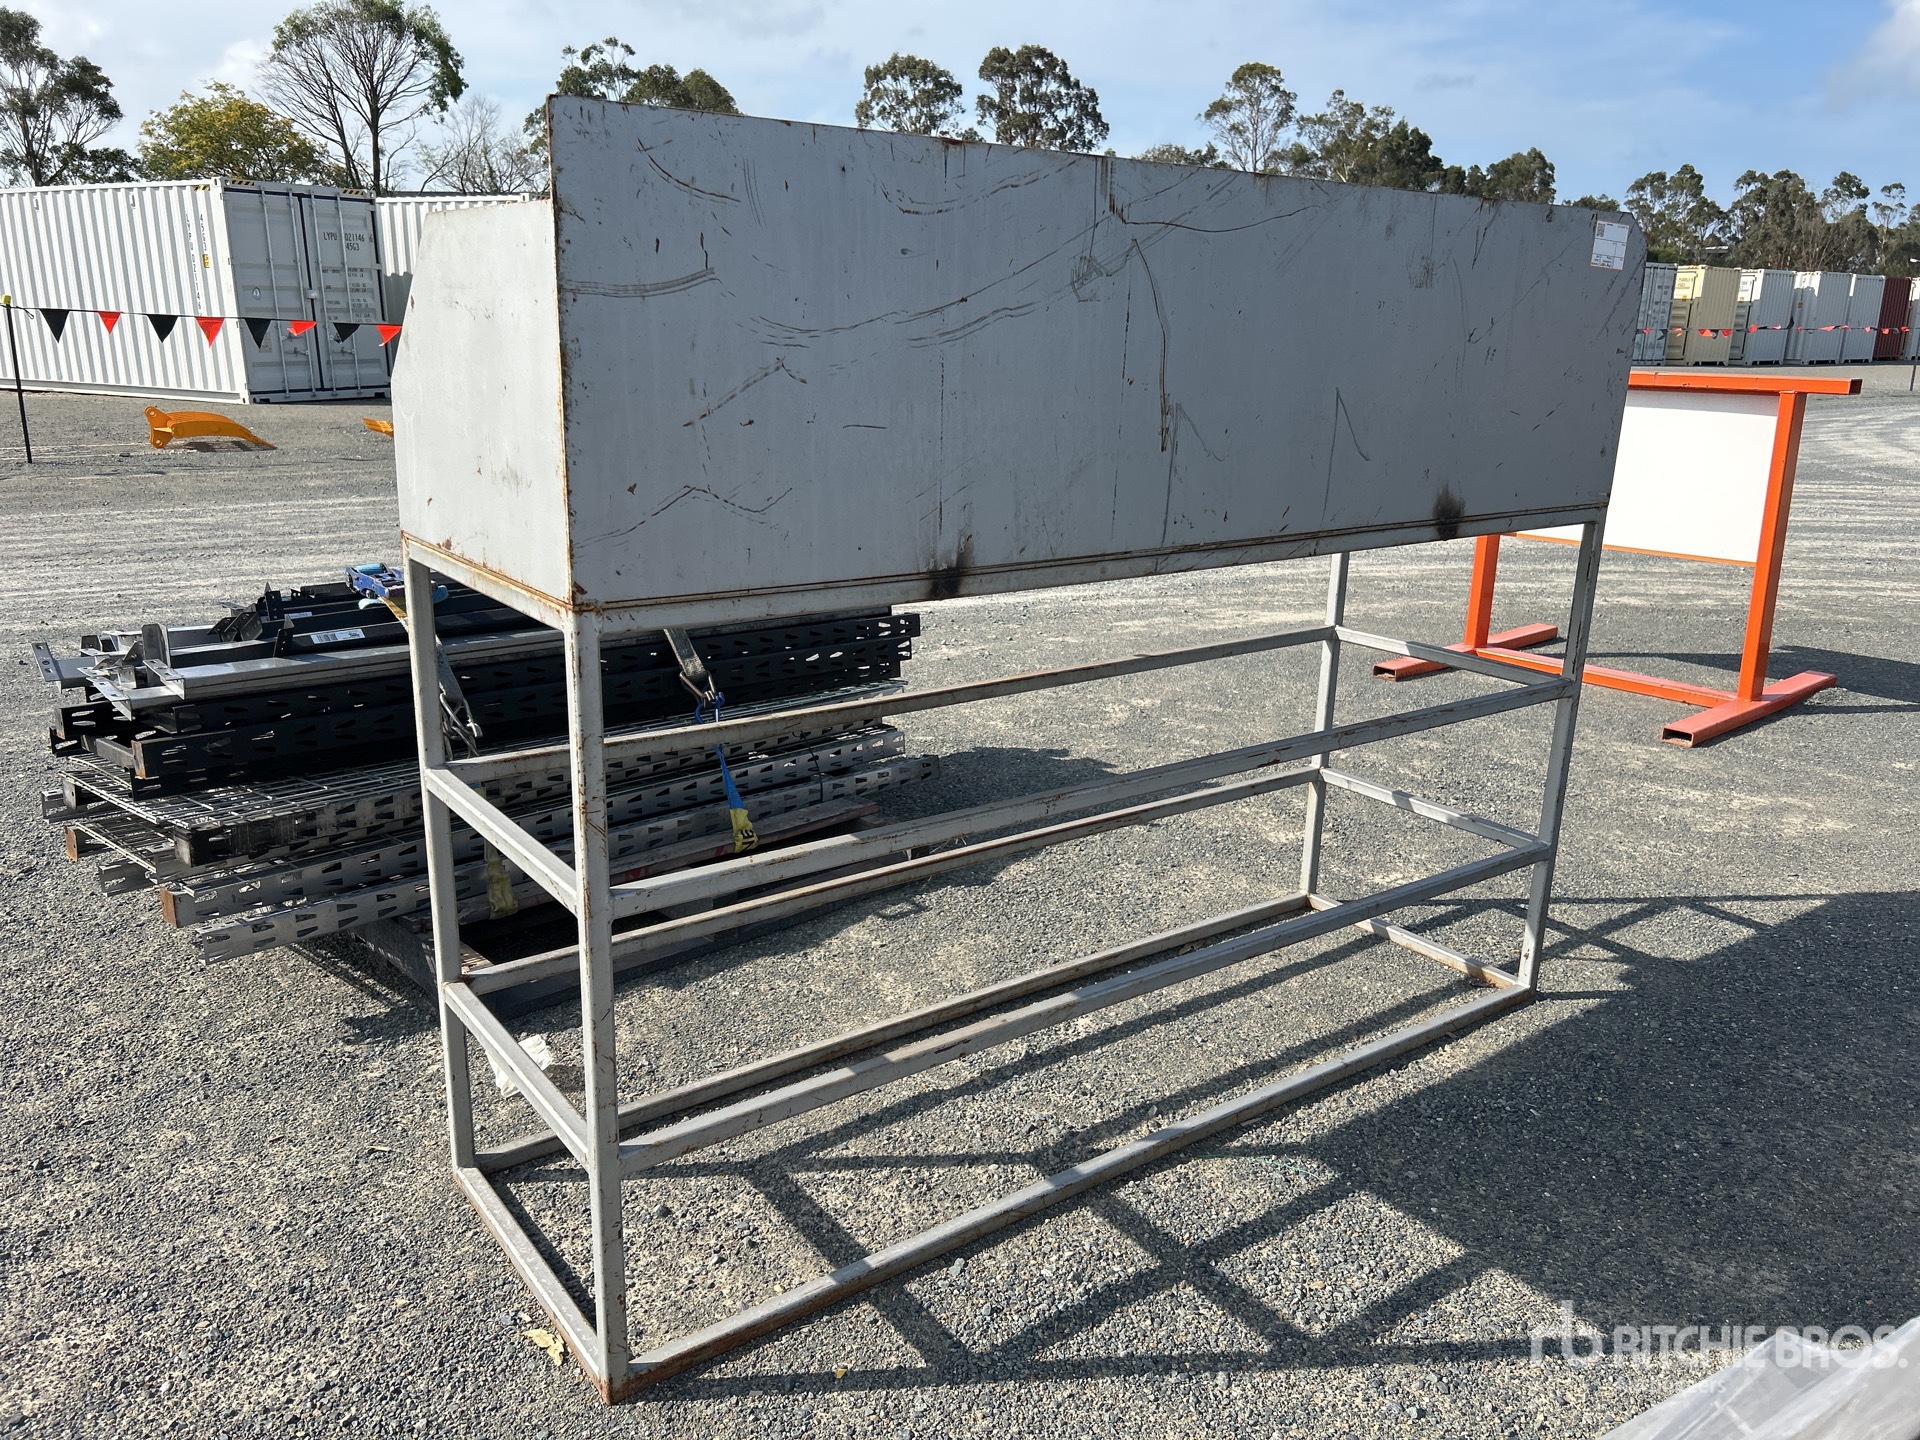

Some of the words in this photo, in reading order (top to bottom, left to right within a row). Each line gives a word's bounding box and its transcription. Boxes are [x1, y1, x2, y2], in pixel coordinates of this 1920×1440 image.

[323, 231, 338, 241] LYPU
[344, 233, 365, 243] 021146
[345, 243, 360, 252] 45G3
